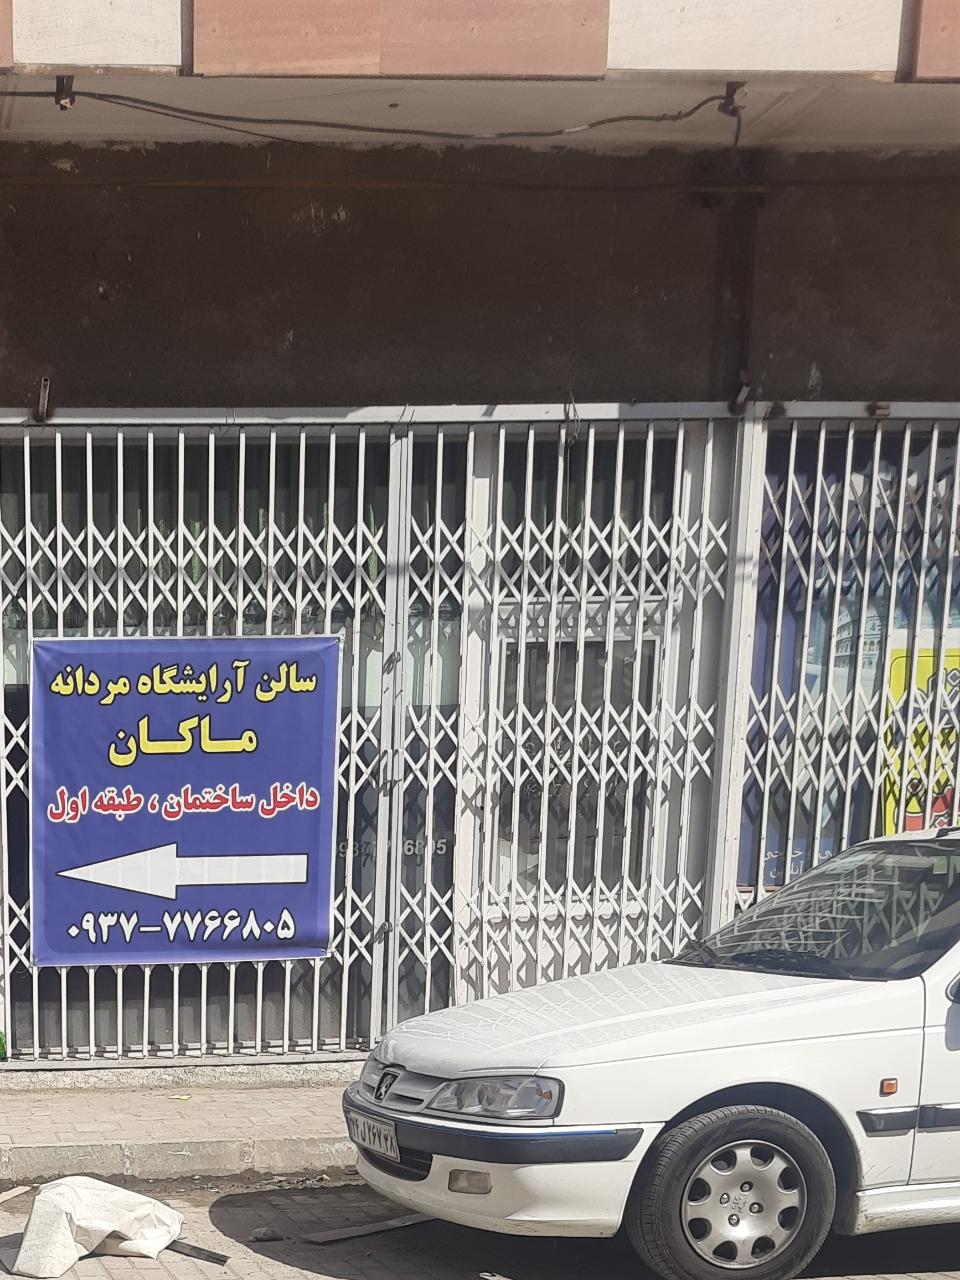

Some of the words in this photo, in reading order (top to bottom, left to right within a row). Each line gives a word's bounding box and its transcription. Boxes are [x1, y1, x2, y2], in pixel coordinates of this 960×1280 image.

[50, 664, 131, 706] مردانه
[137, 659, 250, 704] آرایشگاه
[255, 660, 317, 703] سالن
[108, 714, 258, 767] ماکان
[48, 786, 89, 823] اول
[92, 785, 143, 821] طبقه
[259, 782, 320, 818] داخل
[67, 908, 297, 945] ۰۹۳۷-۷۷۶۶۸۰۵
